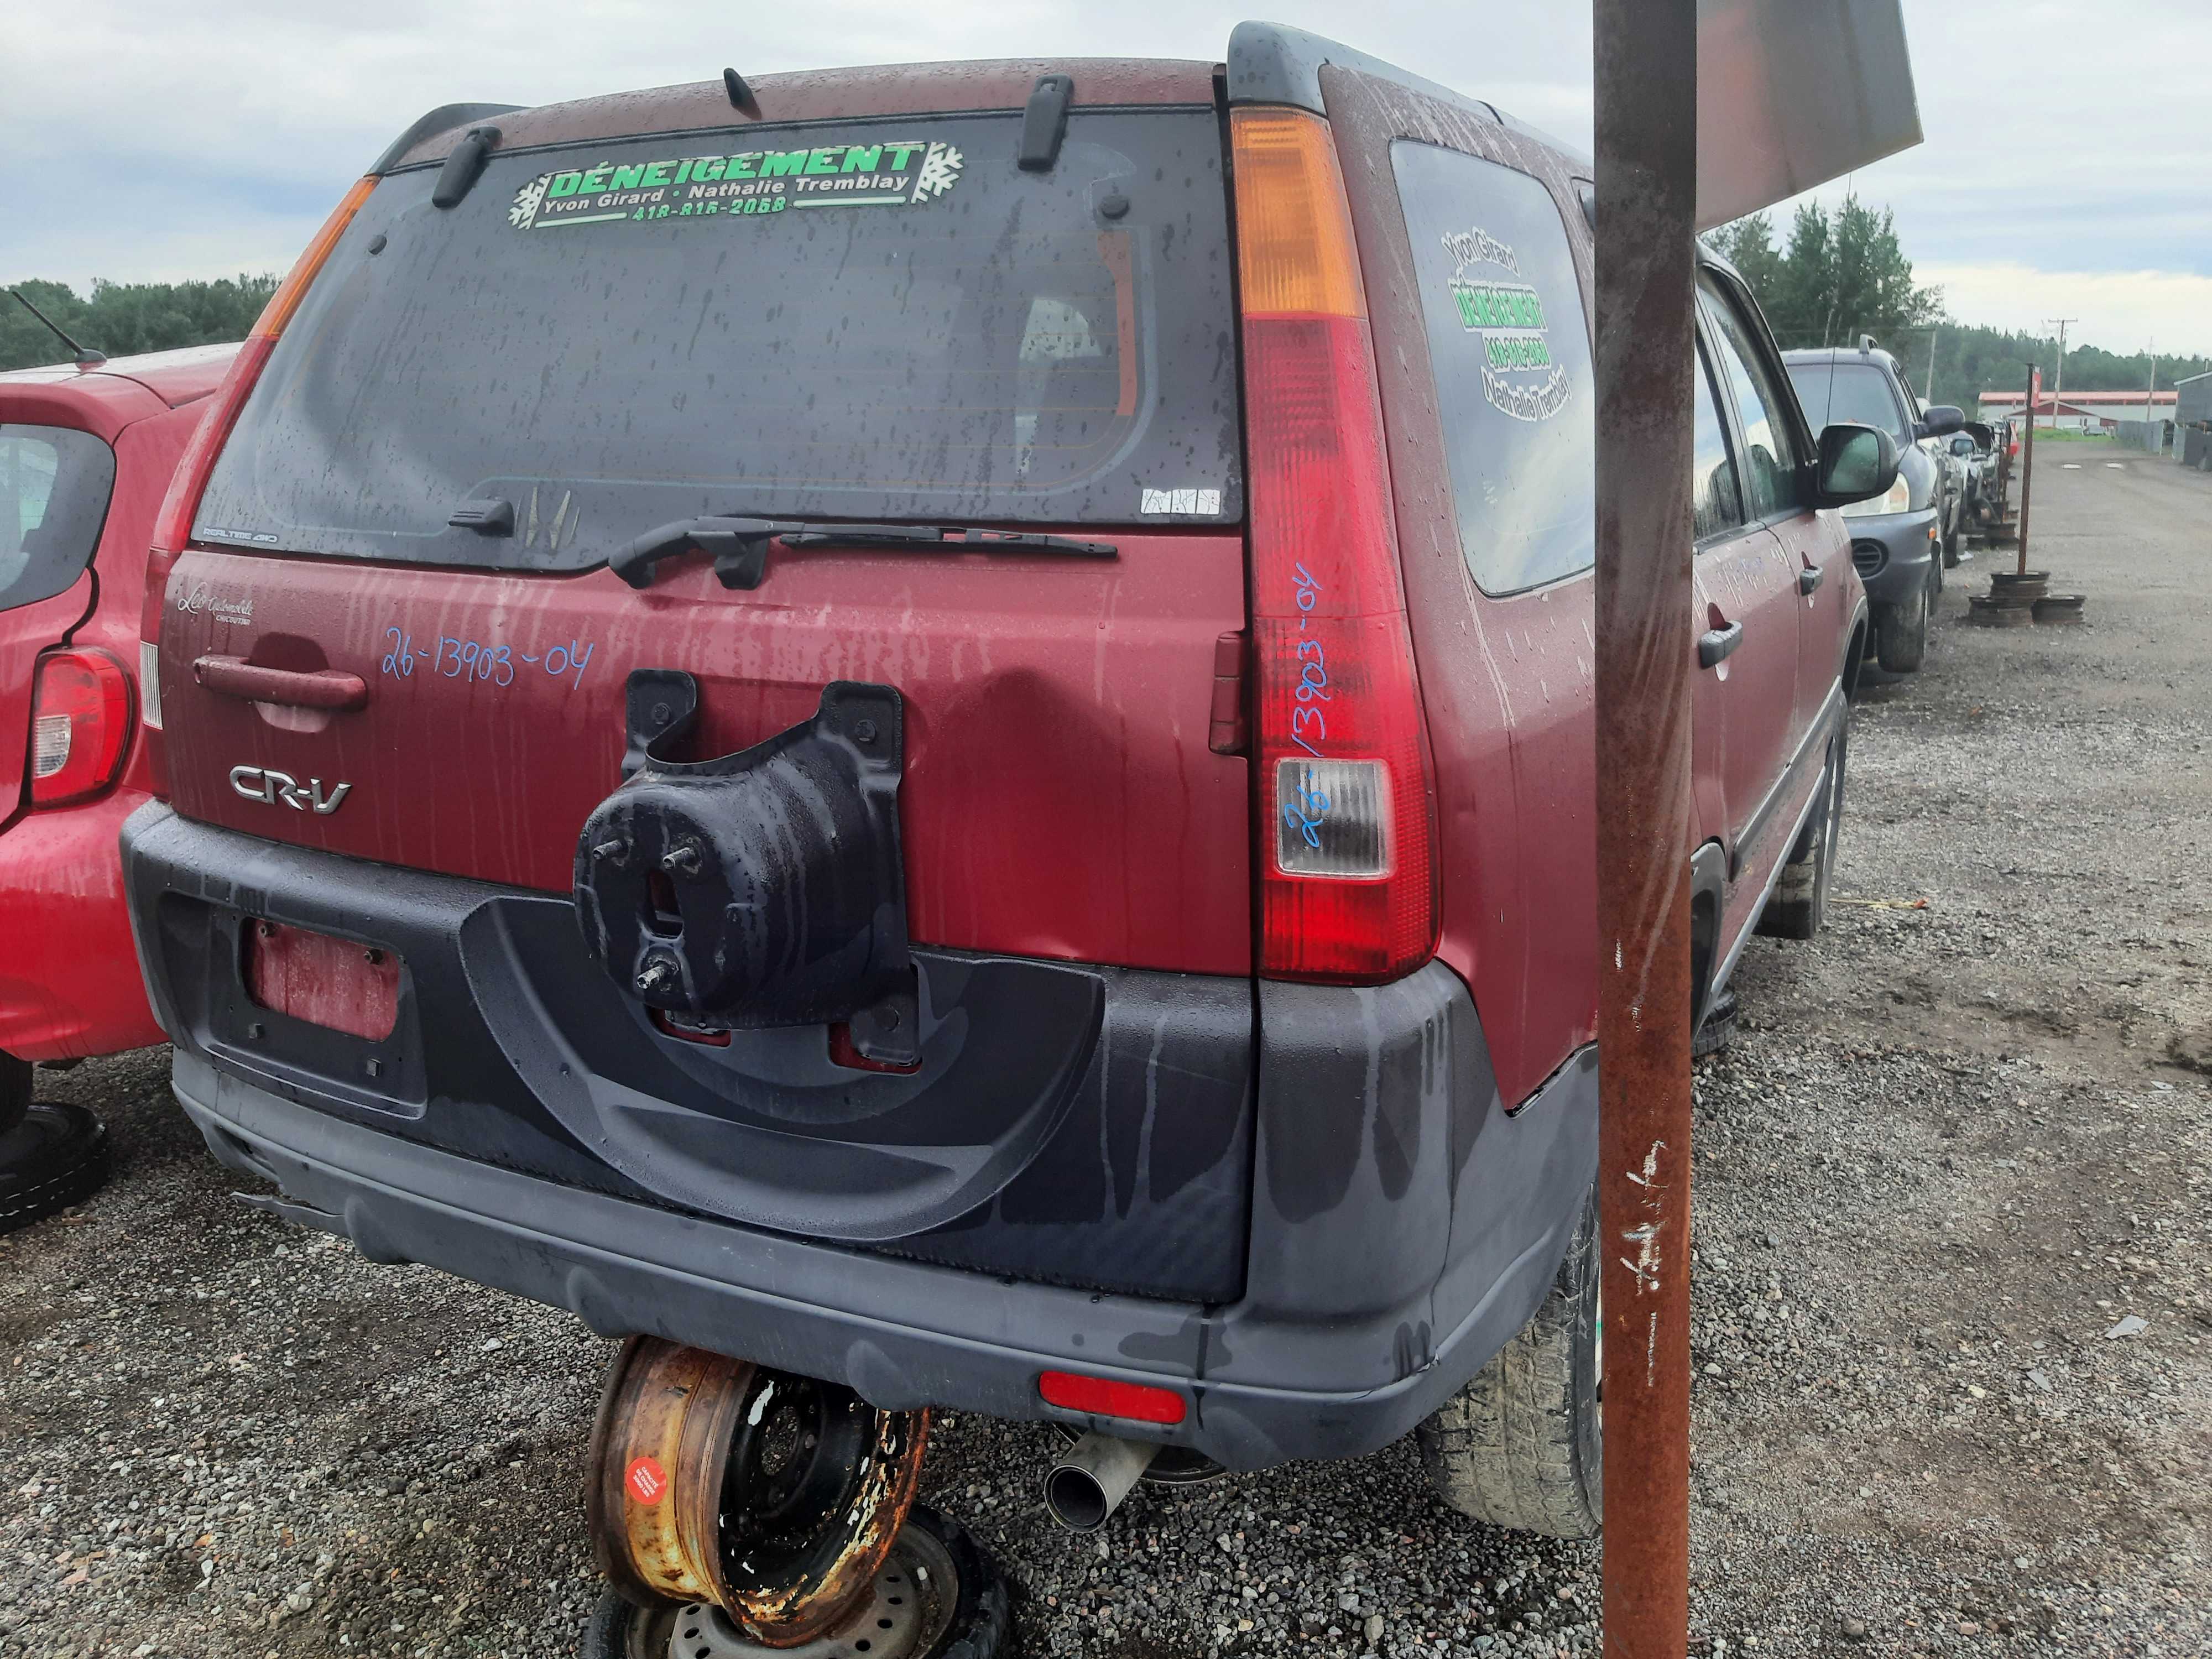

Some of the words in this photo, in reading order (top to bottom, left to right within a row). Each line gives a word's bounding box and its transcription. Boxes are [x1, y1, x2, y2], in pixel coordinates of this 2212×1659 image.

[545, 199, 590, 214] Yvon
[597, 188, 665, 207] Girard
[688, 179, 785, 199] Nathalie
[795, 174, 910, 192] Tremblay
[547, 142, 925, 199] DÉNEIGEMENT
[1442, 233, 1480, 269] Yvon
[1473, 227, 1520, 276] Girard
[1481, 367, 1537, 420] Nathalie
[1530, 365, 1571, 419] Tremblay
[203, 528, 228, 538] REAL
[382, 627, 594, 690] 26-13903-04
[228, 764, 353, 815] CR-V
